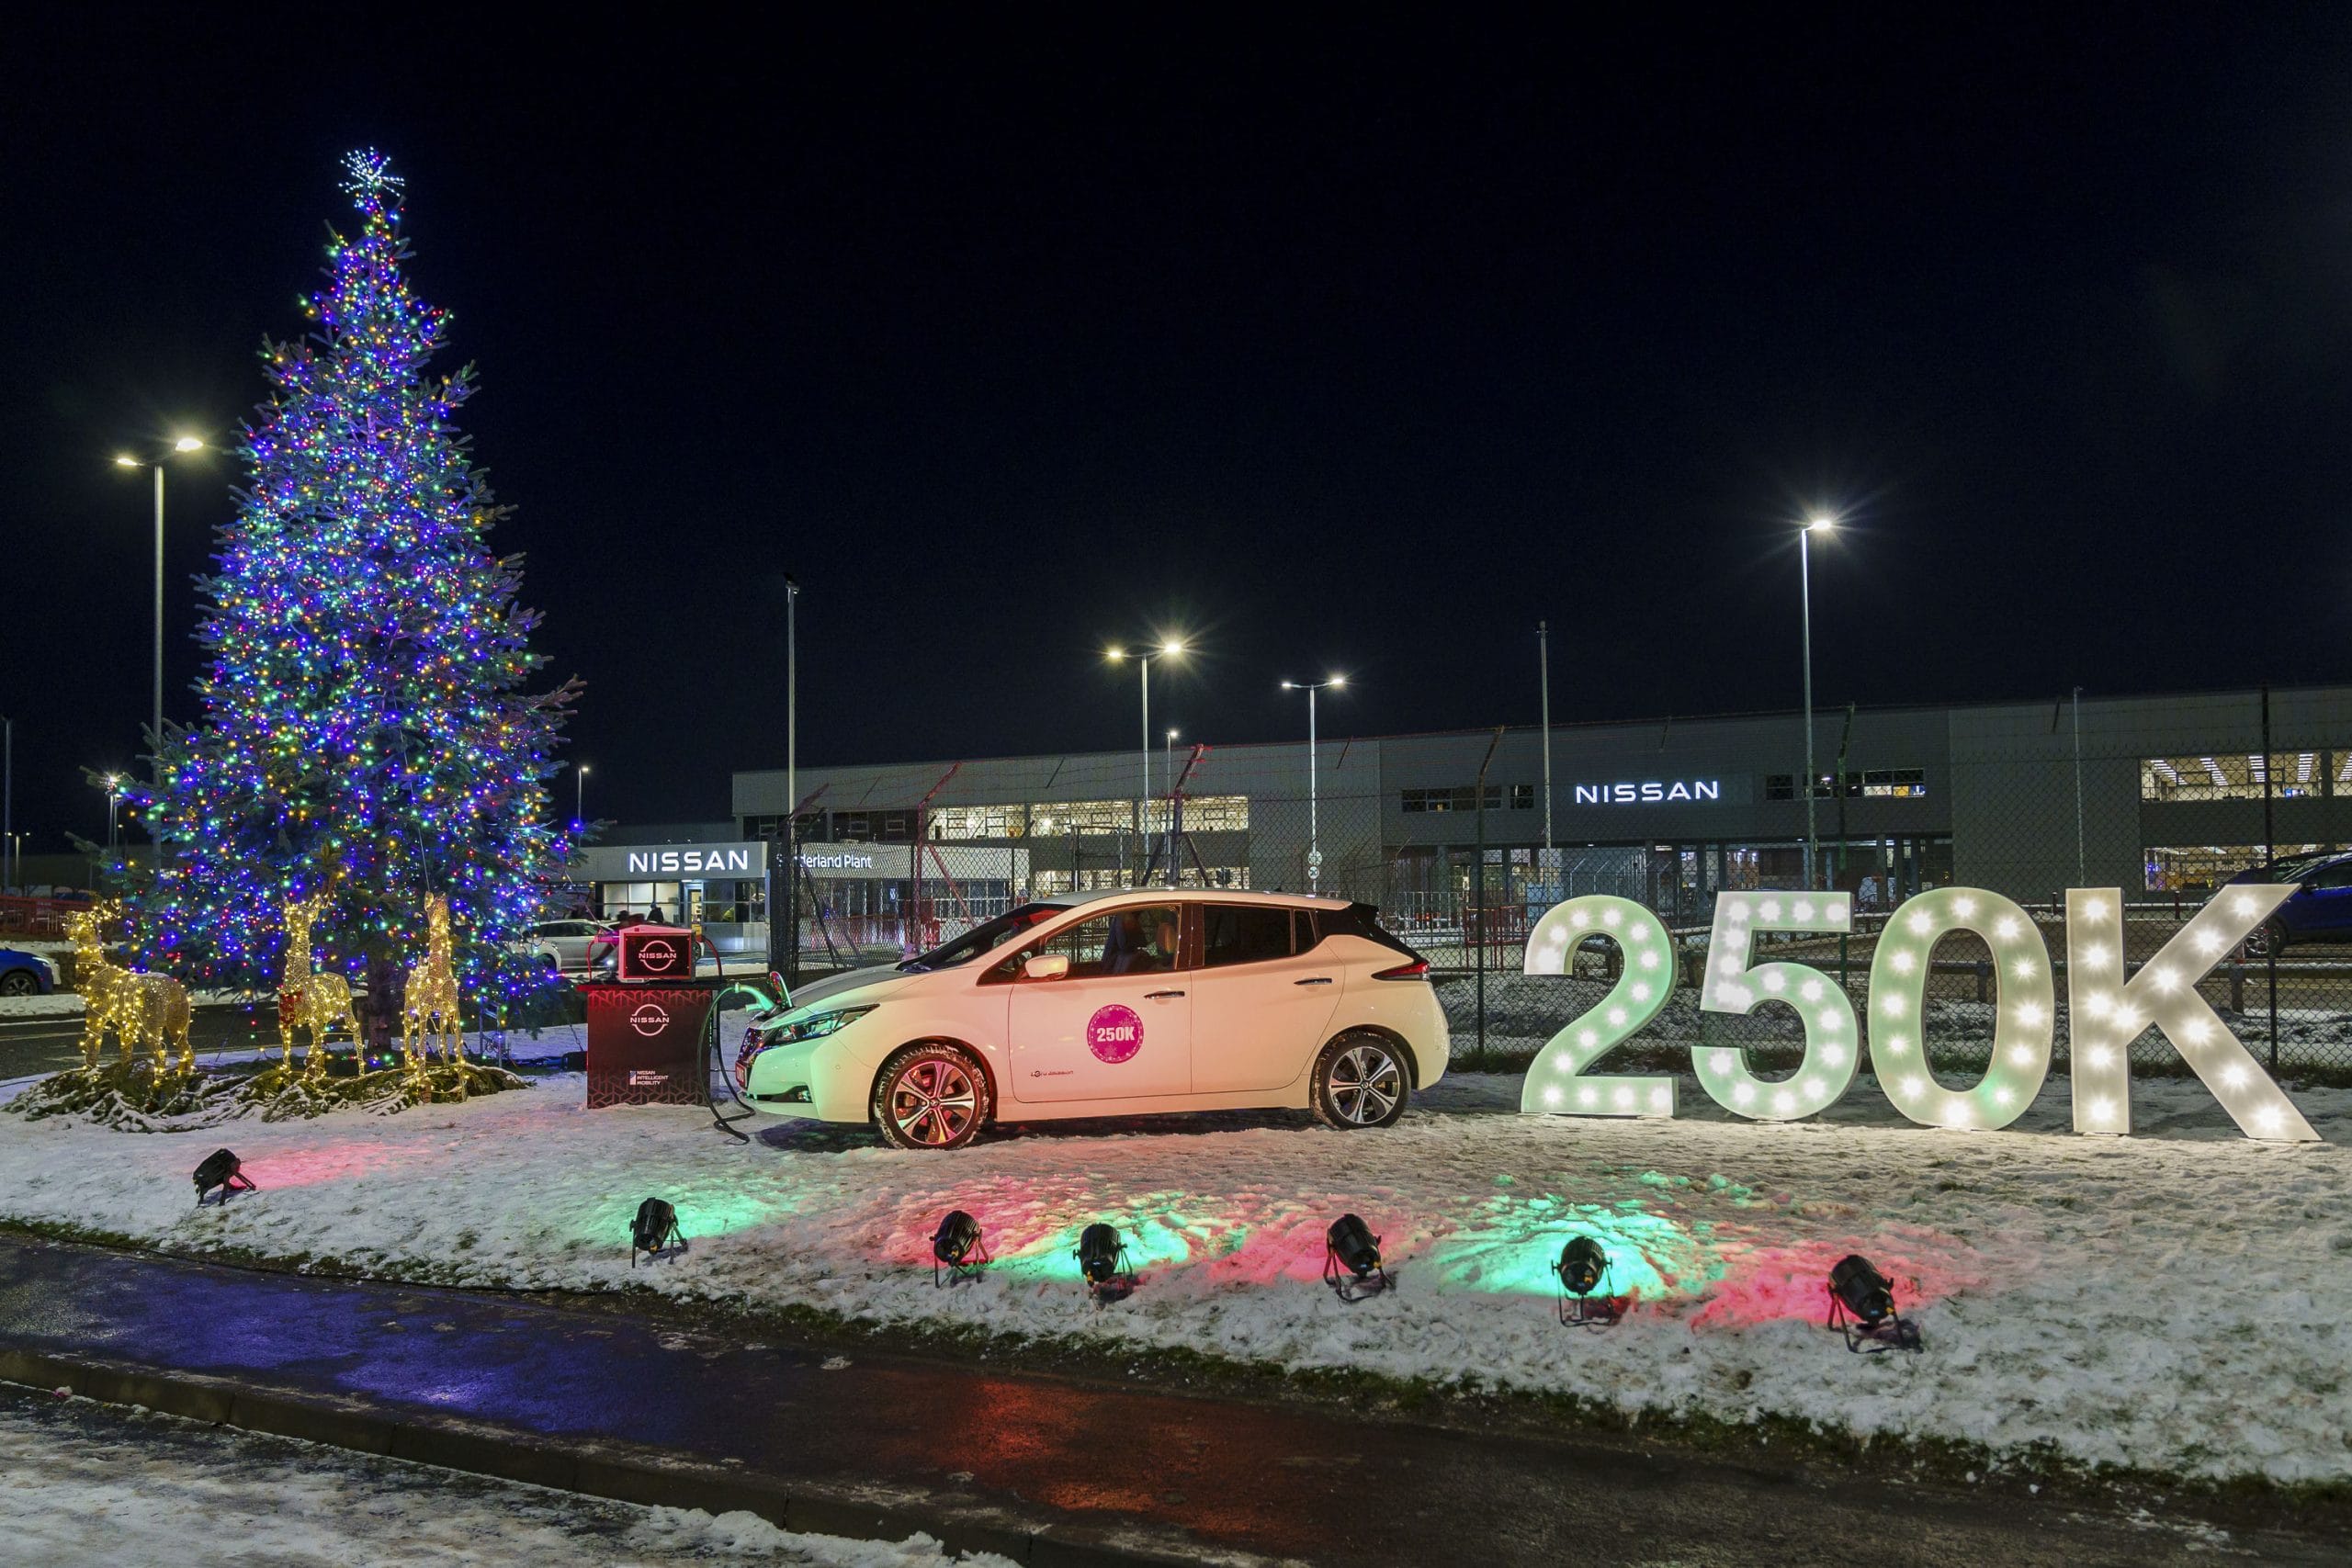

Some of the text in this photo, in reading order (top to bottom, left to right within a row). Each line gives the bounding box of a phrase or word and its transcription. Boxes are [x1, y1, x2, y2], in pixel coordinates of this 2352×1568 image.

[1576, 781, 1718, 804] NISSAN
[629, 850, 748, 873] NISSAN
[843, 855, 872, 868] Plant
[1521, 883, 2323, 1142] 250K
[1096, 1026, 1135, 1043] 250K
